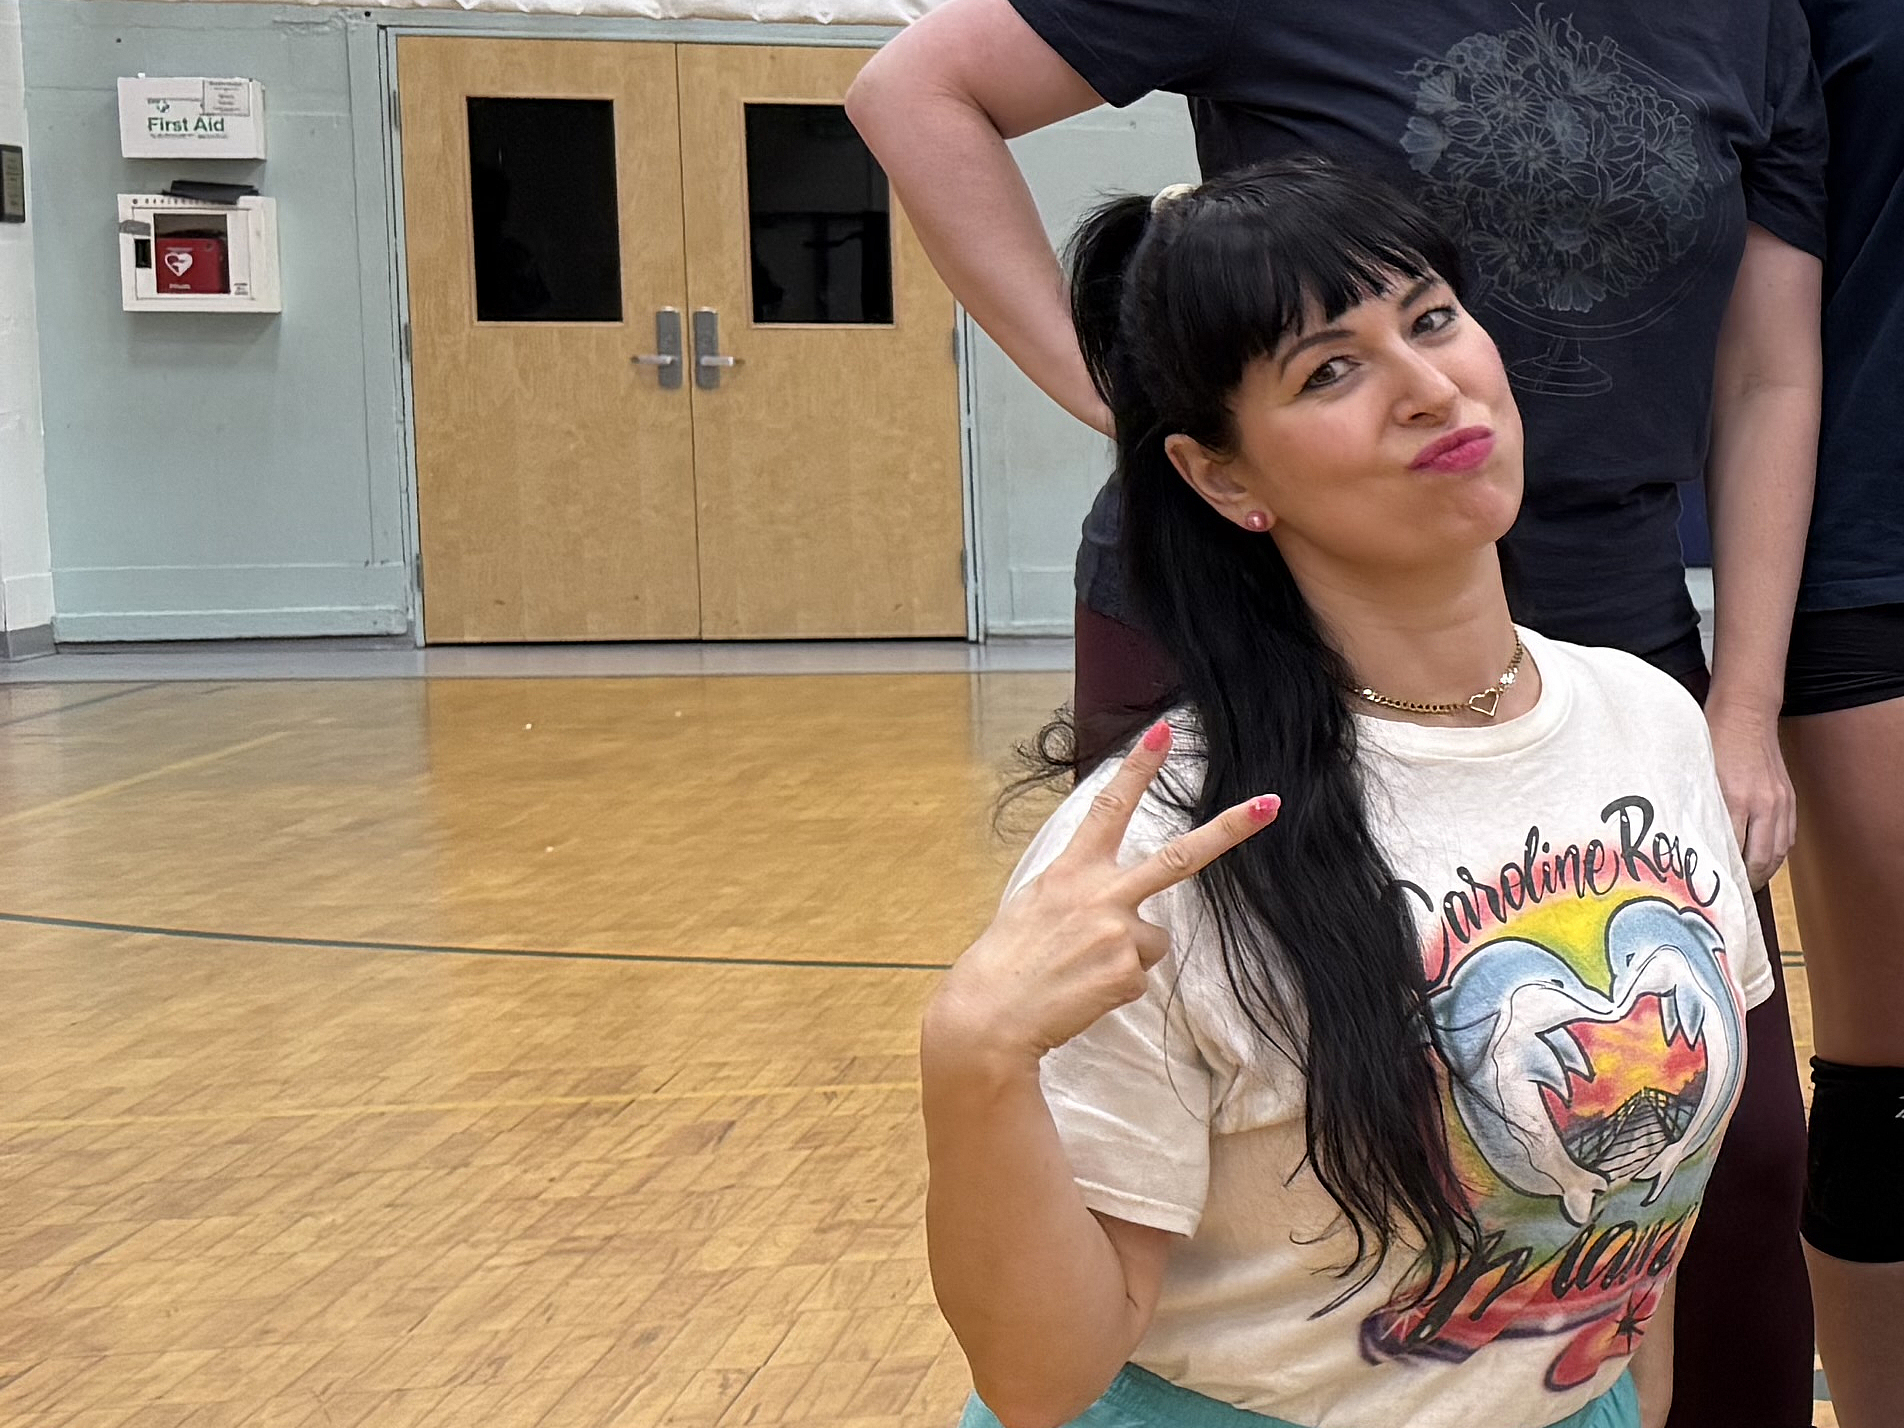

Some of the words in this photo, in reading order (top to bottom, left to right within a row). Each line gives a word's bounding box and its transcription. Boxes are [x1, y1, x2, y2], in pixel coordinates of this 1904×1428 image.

[147, 116, 188, 132] First
[193, 116, 225, 132] Aid
[1600, 794, 1721, 908] Rose
